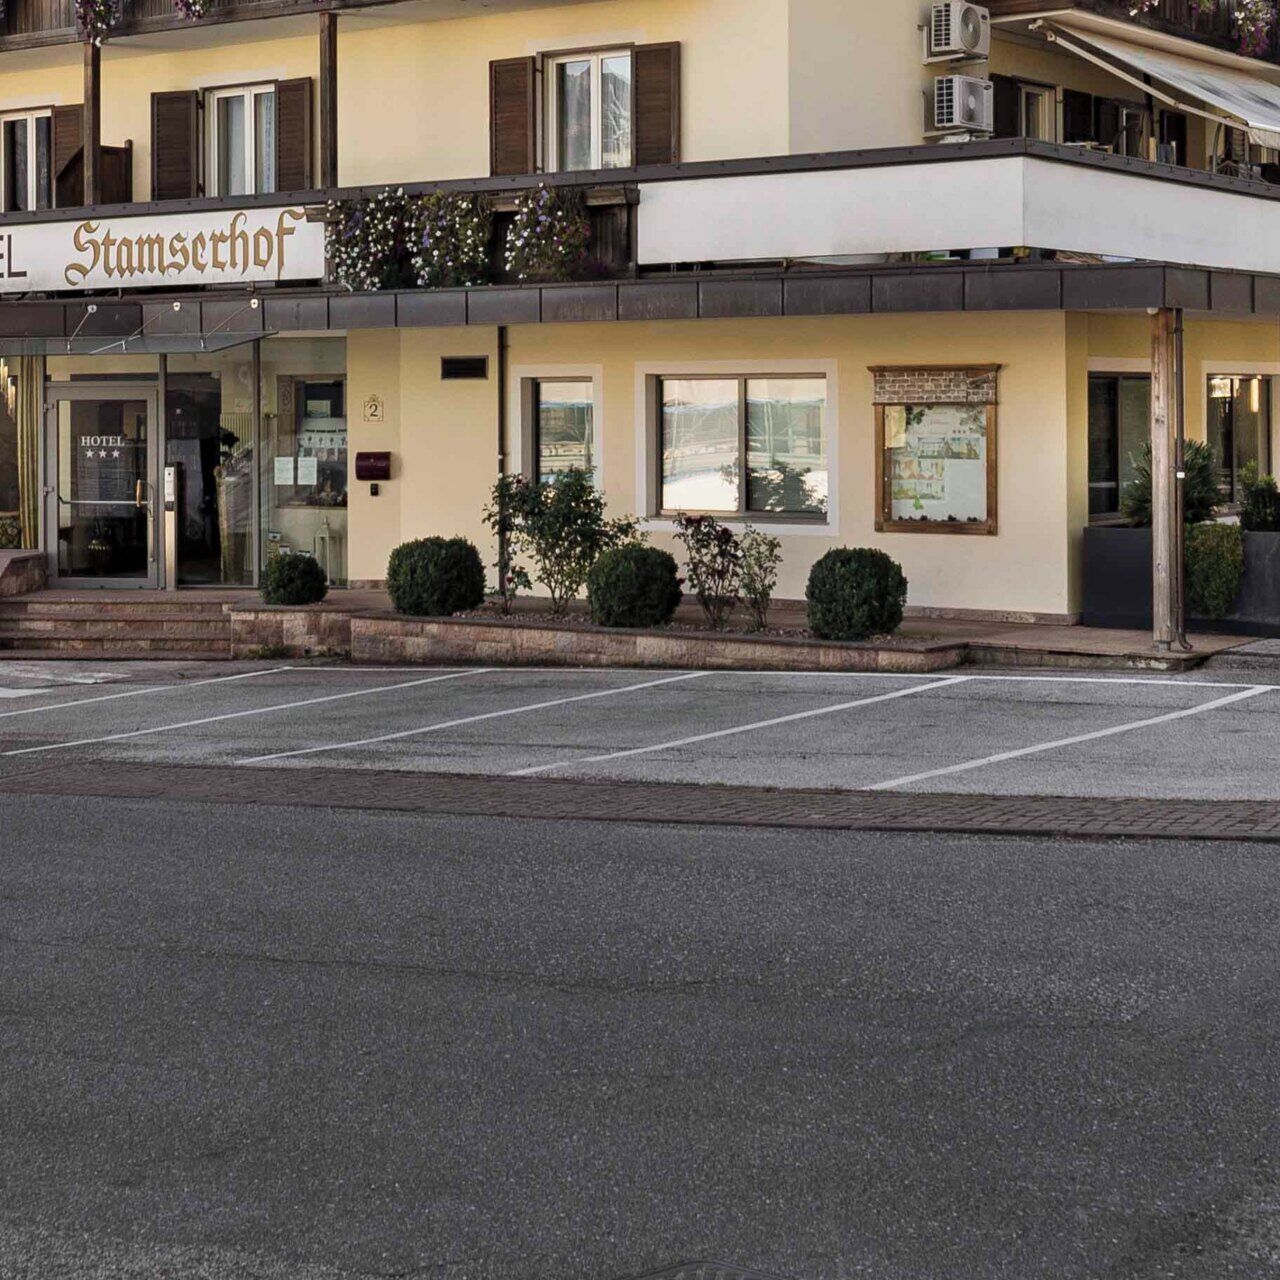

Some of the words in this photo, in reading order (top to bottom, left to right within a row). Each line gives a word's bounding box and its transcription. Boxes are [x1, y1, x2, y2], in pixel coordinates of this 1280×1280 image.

[64, 208, 308, 286] Stamserhof
[368, 403, 379, 417] 2
[80, 435, 125, 447] HOTEL
